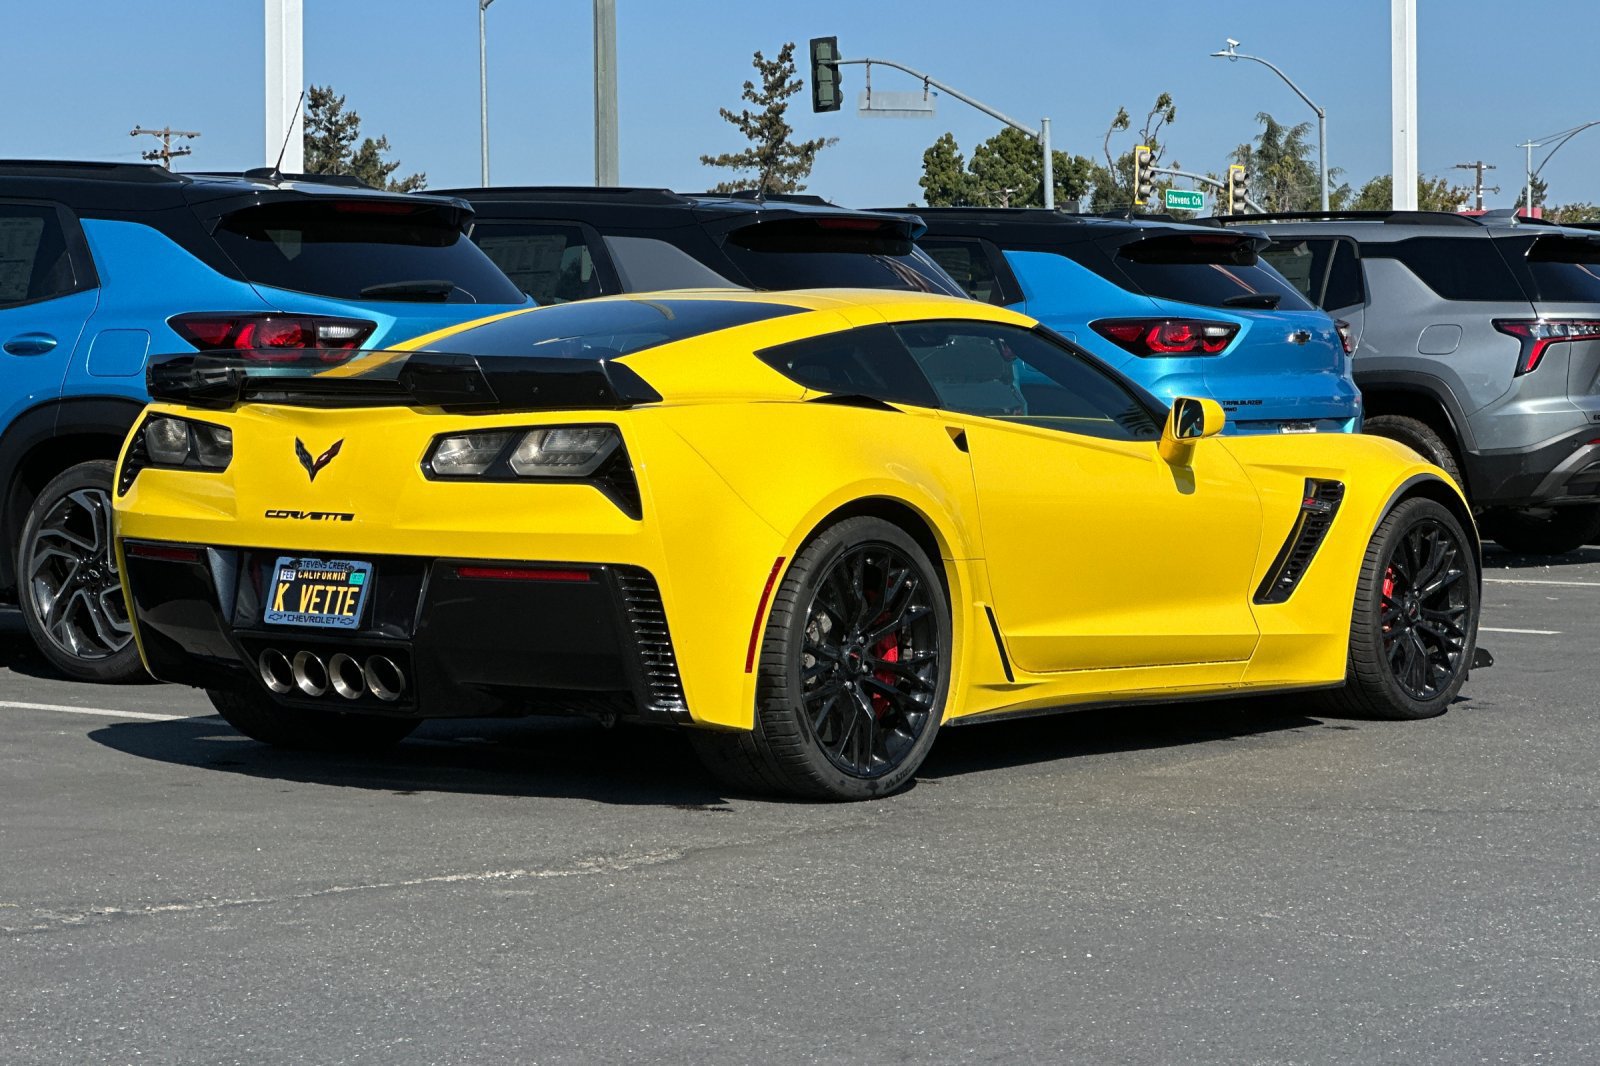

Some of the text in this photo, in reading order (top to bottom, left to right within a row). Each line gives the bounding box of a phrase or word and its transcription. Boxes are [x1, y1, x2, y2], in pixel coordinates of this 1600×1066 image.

[1168, 194, 1201, 206] Stevens Crk
[265, 509, 355, 521] CORVETTE
[298, 560, 350, 571] STEVENS CREEK
[298, 571, 346, 580] CALIFORNIA
[273, 582, 360, 616] K VETTE
[287, 614, 336, 624] CHEVROLET
